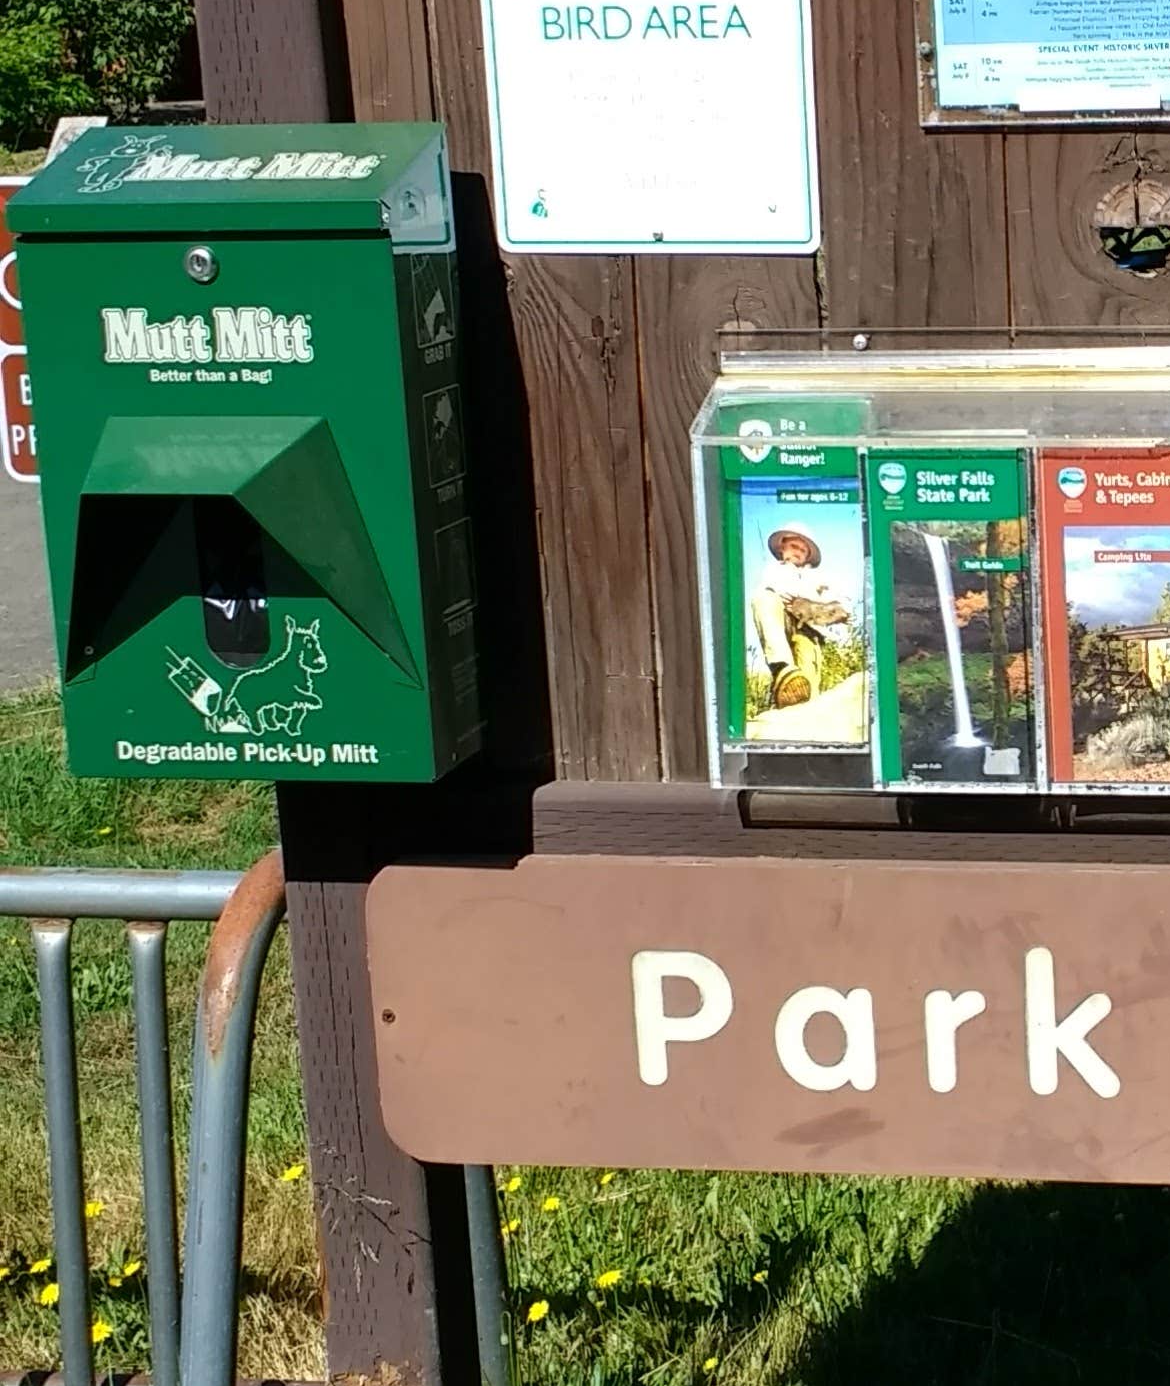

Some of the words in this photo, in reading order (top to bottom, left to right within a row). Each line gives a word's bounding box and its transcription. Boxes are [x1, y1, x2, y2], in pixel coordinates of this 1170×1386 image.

[542, 4, 633, 41] BIRD
[642, 4, 752, 40] AREA
[1038, 45, 1071, 54] SPECIAL
[1103, 43, 1142, 51] HISTORIC
[1143, 42, 1170, 51] SILVER
[124, 153, 262, 181] Mutt
[253, 151, 381, 180] Mitt
[102, 307, 213, 363] Mutt
[213, 306, 315, 363] Mitt
[149, 369, 193, 383] Better
[195, 369, 226, 382] than
[228, 372, 239, 382] a
[241, 368, 273, 385] Bag!
[780, 418, 796, 432] Be
[798, 421, 807, 432] a
[780, 451, 826, 468] Ranger!
[916, 470, 958, 487] Silver
[961, 470, 995, 487] Falls
[1094, 472, 1133, 489] Yurts,
[780, 493, 797, 502] Fun
[829, 491, 849, 502] 6-12
[916, 487, 956, 503] State
[959, 487, 991, 503] Park
[1095, 490, 1107, 504] &
[1109, 489, 1155, 506] Tepees
[1097, 551, 1134, 563] Camping
[116, 740, 237, 765] Degradable
[244, 743, 326, 767] Pick-Up
[333, 743, 379, 764] Mitt
[632, 947, 1122, 1099] Park
